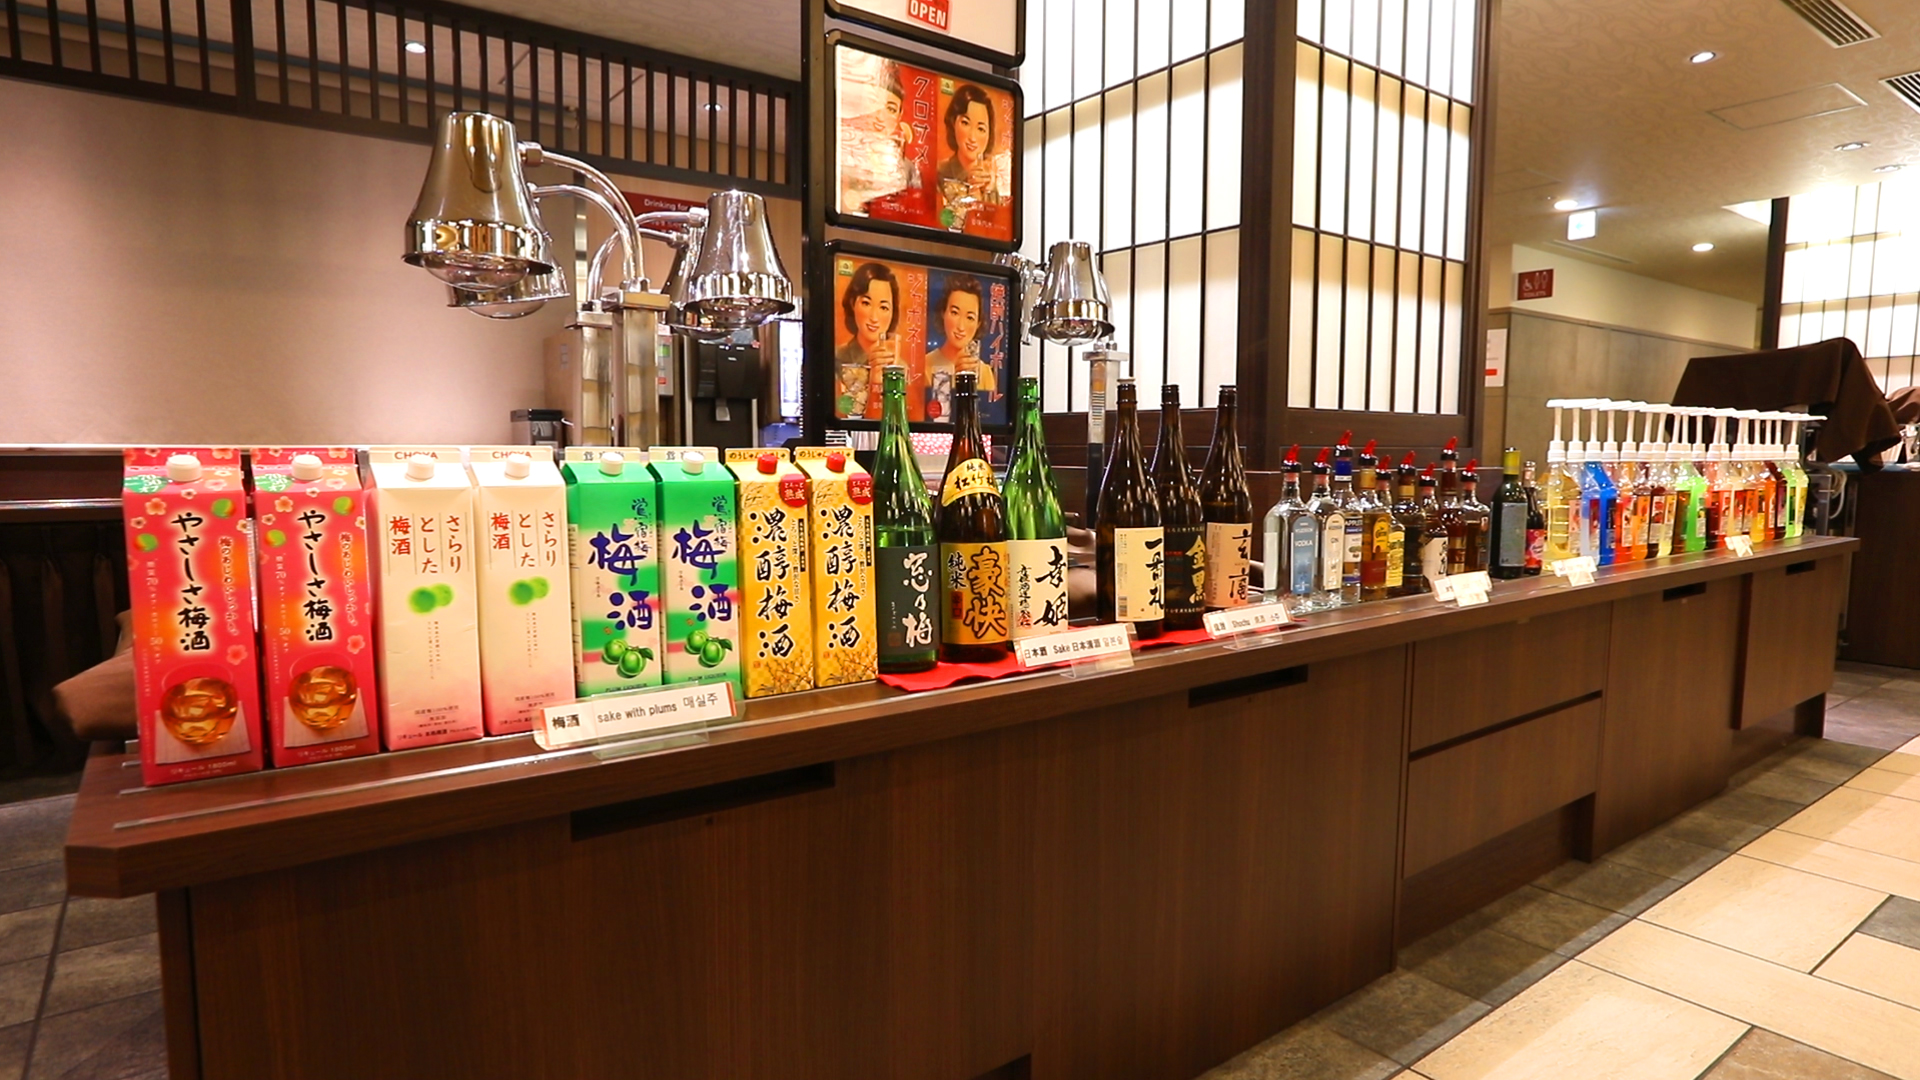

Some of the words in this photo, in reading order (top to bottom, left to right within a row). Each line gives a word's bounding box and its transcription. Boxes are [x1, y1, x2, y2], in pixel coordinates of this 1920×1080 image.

[910, 0, 946, 27] OPEN
[643, 199, 677, 211] Drinking
[677, 203, 689, 211] for
[389, 515, 411, 555] 梅酒
[420, 516, 438, 573] とした
[446, 515, 462, 573] さらり
[491, 512, 510, 550] 梅酒
[519, 513, 535, 567] とした
[542, 512, 557, 567] さらり
[588, 523, 653, 630] 梅酒
[672, 519, 732, 622] 梅酒
[749, 508, 793, 658] 濃醇梅酒
[821, 505, 860, 649] 濃醇梅酒
[948, 551, 967, 591] 純米
[963, 545, 1007, 639] 豪快
[1024, 646, 1048, 659] 日本酒
[1053, 644, 1070, 655] Sake
[552, 713, 581, 730] 梅酒
[597, 708, 622, 723] sake
[625, 704, 647, 719] with
[649, 701, 678, 716] plums
[682, 692, 718, 709] 매실주
